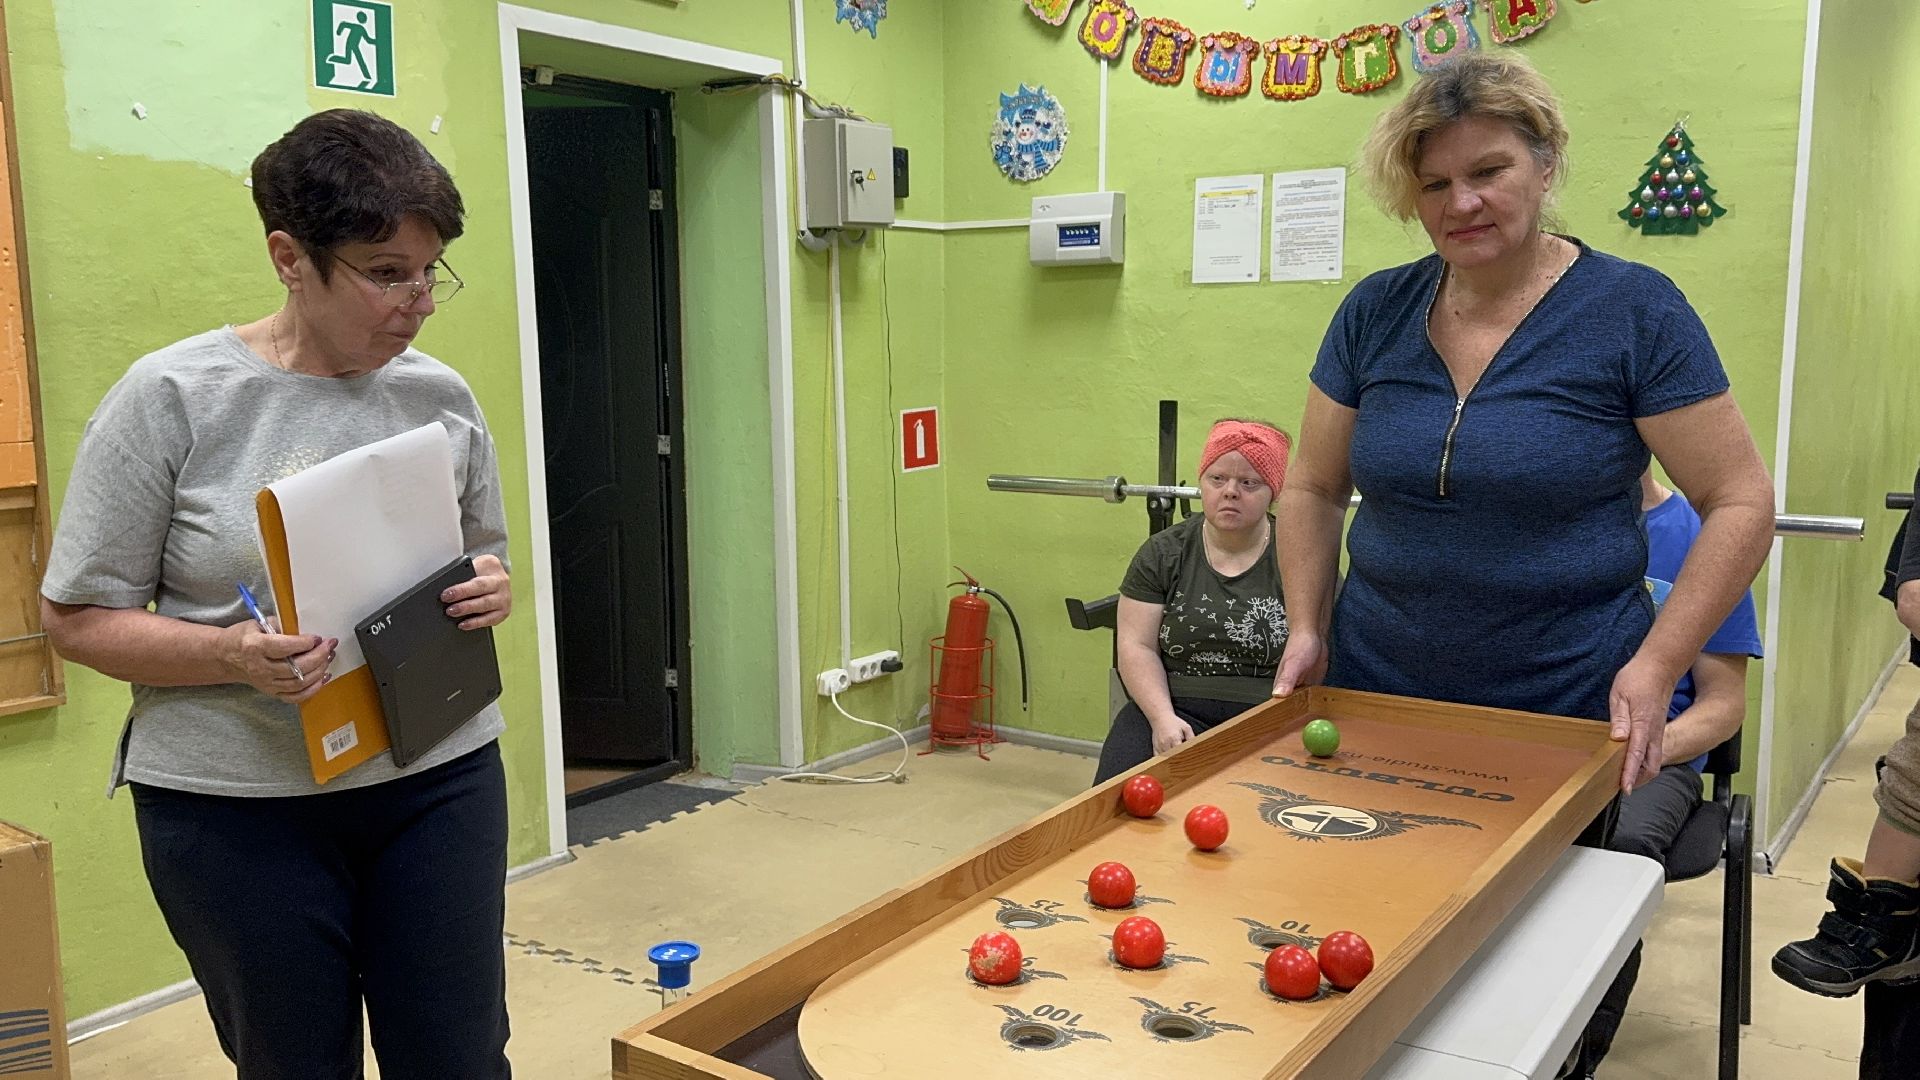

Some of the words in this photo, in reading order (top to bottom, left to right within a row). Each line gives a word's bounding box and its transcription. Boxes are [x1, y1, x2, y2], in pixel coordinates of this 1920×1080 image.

[1040, 0, 1309, 86] ОВЫМ
[1260, 755, 1515, 802] CULBUTO
[1029, 899, 1064, 912] 25
[1280, 920, 1311, 934] 10
[1032, 1004, 1084, 1027] 100
[1177, 1001, 1217, 1019] 75
